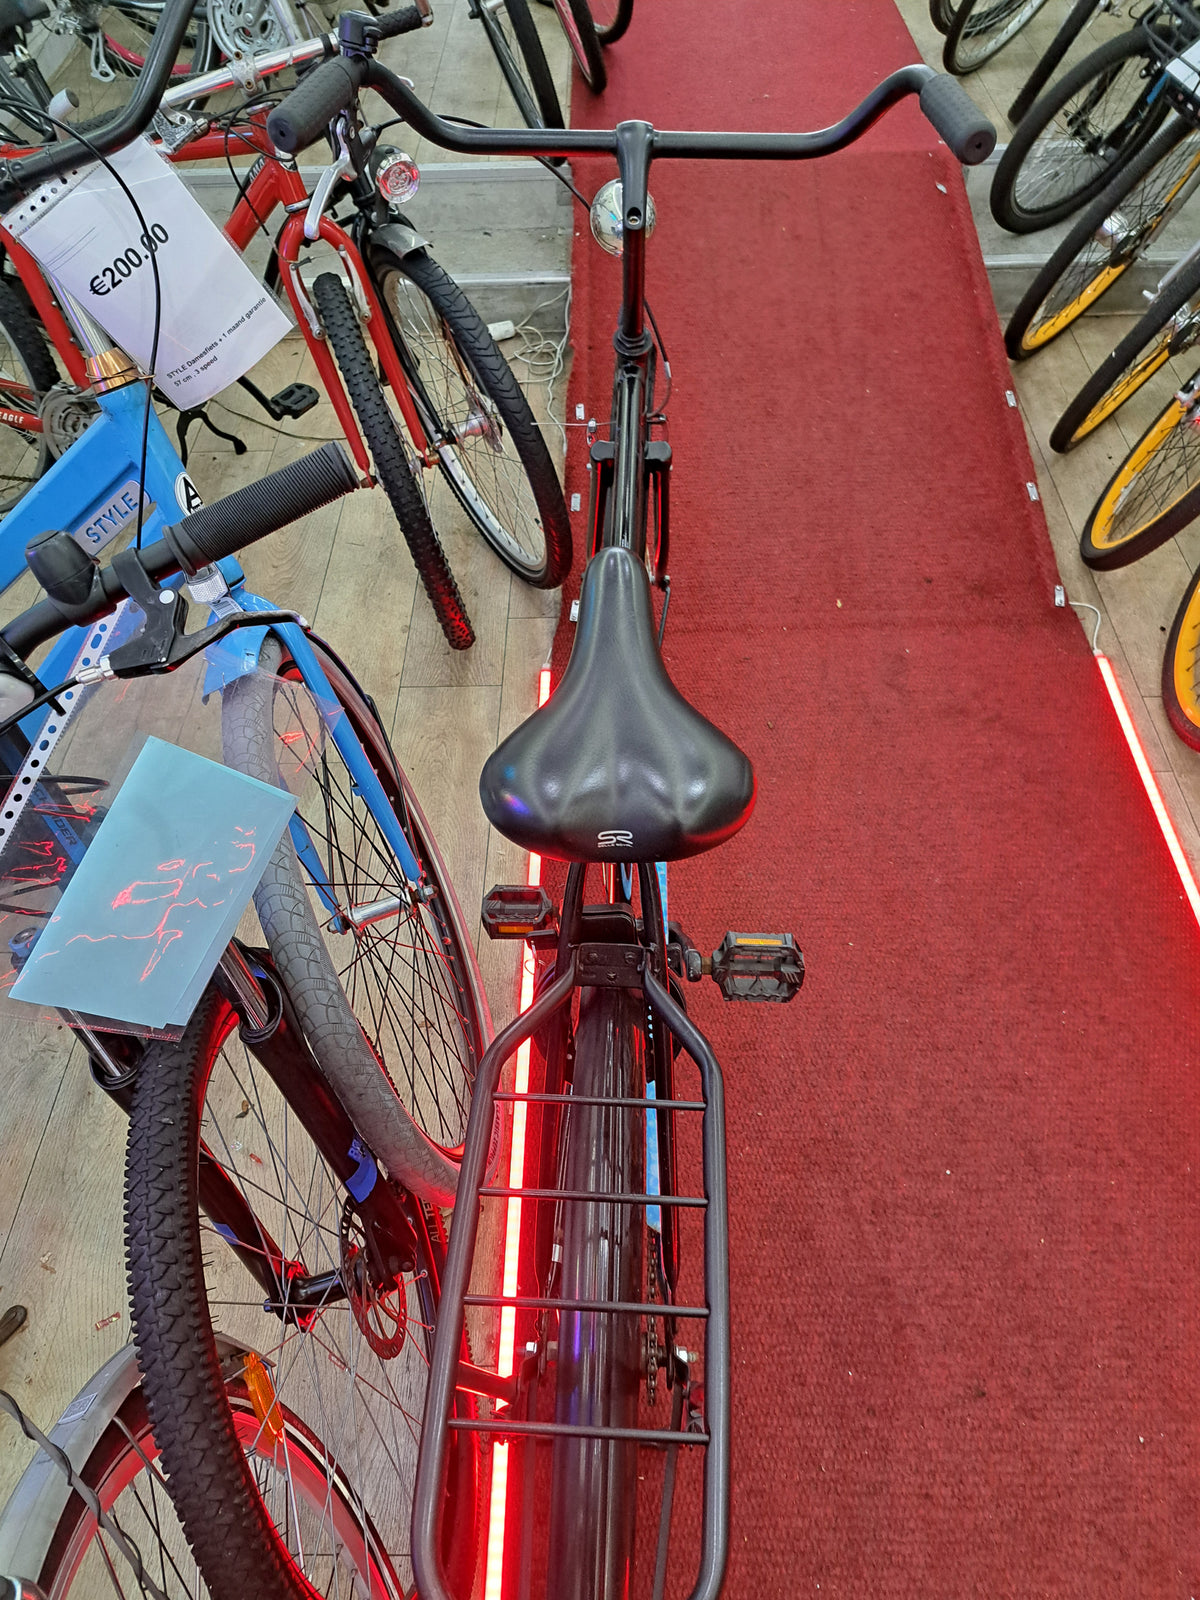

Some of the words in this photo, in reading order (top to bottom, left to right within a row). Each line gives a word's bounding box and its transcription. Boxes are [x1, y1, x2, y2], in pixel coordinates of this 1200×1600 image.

[89, 223, 169, 296] €200.00
[166, 365, 188, 379] STYLE
[187, 341, 219, 367] Damesfiets
[226, 316, 246, 335] maand
[245, 297, 267, 320] garantie
[182, 374, 192, 383] cm
[200, 355, 218, 373] speed
[85, 491, 139, 544] STYLE
